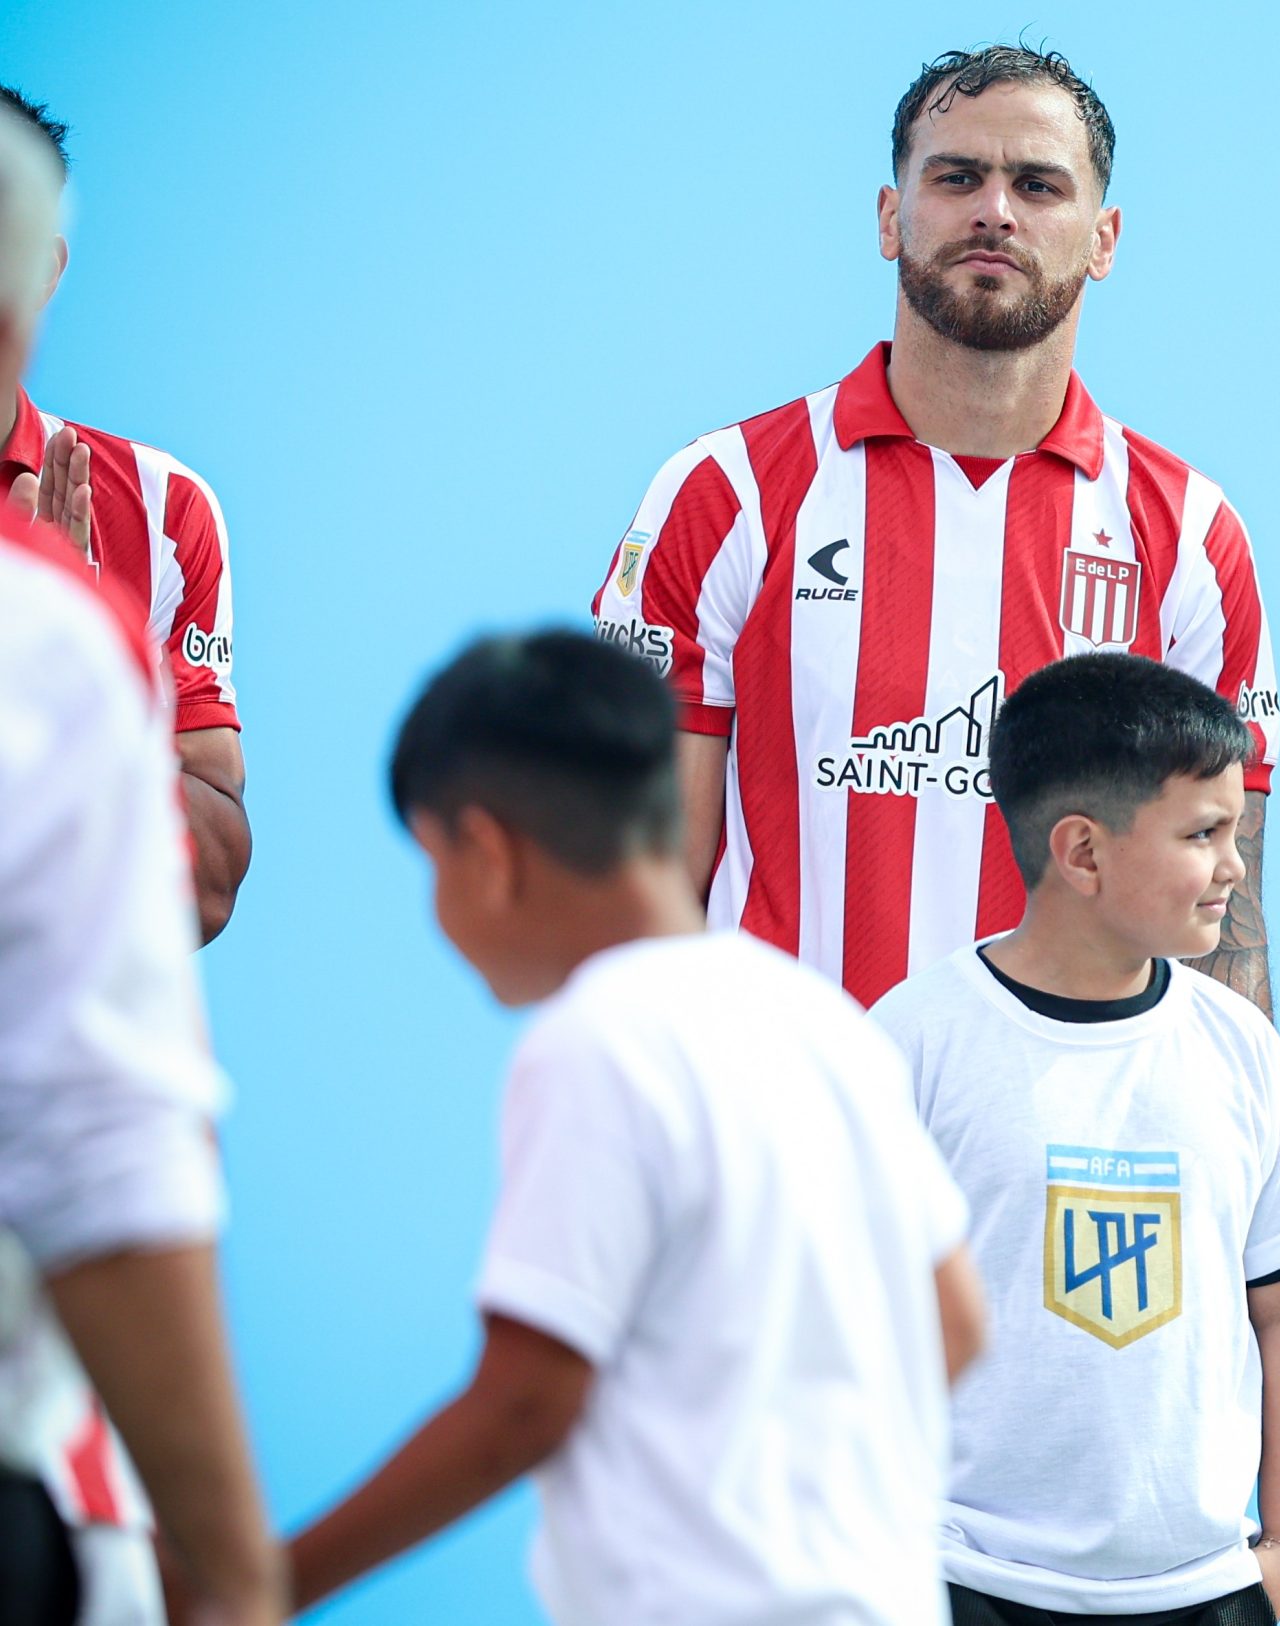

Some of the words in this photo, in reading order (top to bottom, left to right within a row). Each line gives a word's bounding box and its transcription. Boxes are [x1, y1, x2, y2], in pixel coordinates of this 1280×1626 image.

[1074, 557, 1130, 582] EdeLP
[794, 587, 859, 602] RUGE
[1089, 1155, 1131, 1178] AFA
[1063, 1207, 1162, 1322] LPF
